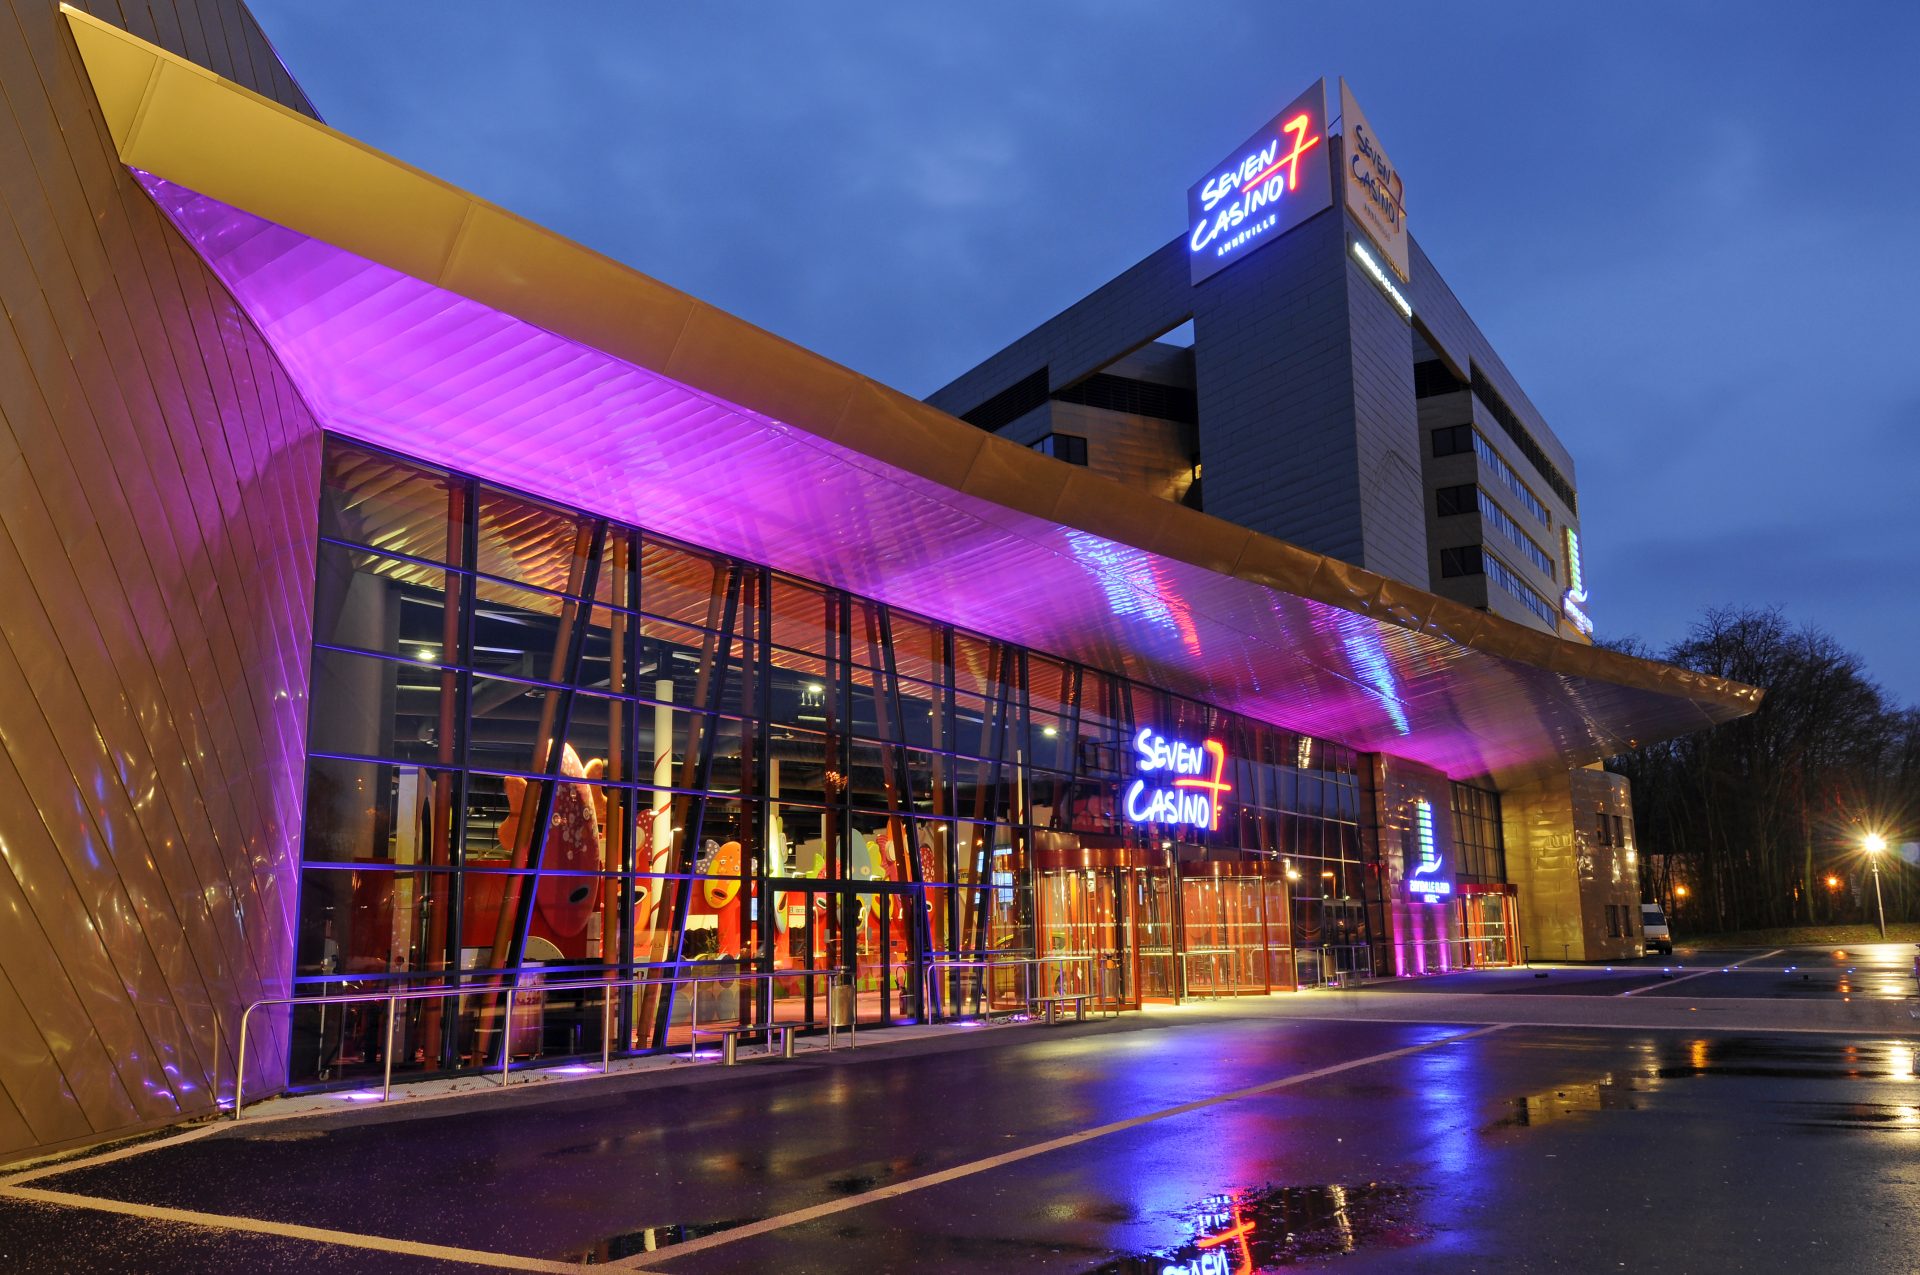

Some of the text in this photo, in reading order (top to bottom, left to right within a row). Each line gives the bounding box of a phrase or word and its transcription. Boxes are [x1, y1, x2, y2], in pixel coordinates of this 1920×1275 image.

[1200, 139, 1278, 212] SEVEN
[1355, 124, 1391, 185] SEVEN
[1190, 174, 1285, 252] CASINO
[1352, 153, 1396, 224] CASINO
[1135, 727, 1203, 775] SEVEN
[1125, 779, 1210, 829] CASINO
